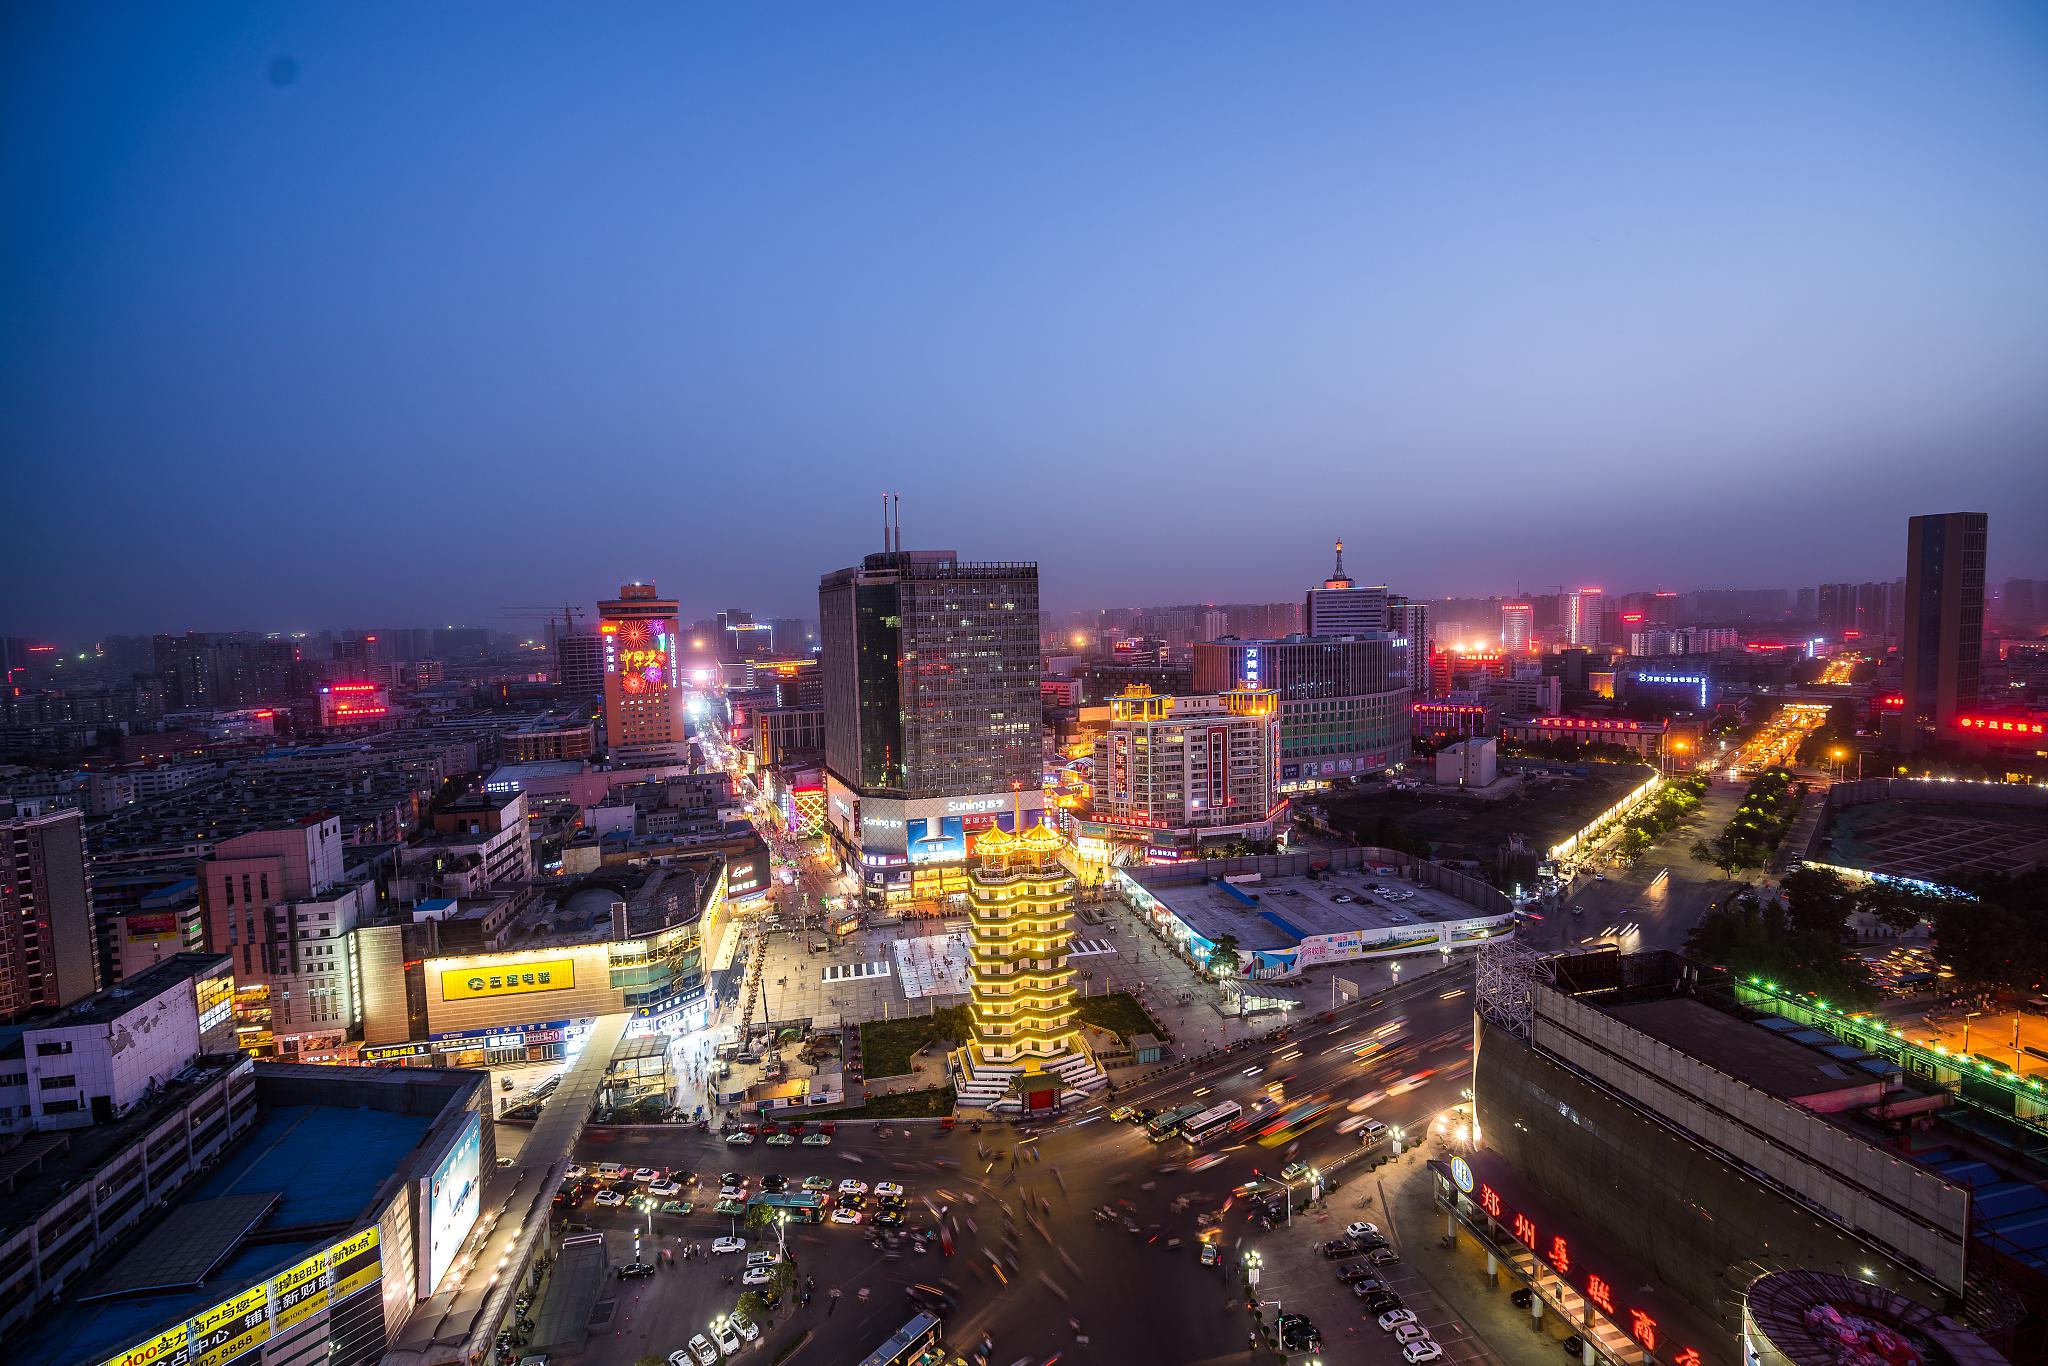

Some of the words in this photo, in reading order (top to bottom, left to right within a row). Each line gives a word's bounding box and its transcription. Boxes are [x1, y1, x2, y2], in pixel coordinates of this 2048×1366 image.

[948, 800, 986, 812] Suning
[863, 817, 889, 829] Suning
[489, 971, 551, 989] 五星电器
[221, 1335, 253, 1359] 8888
